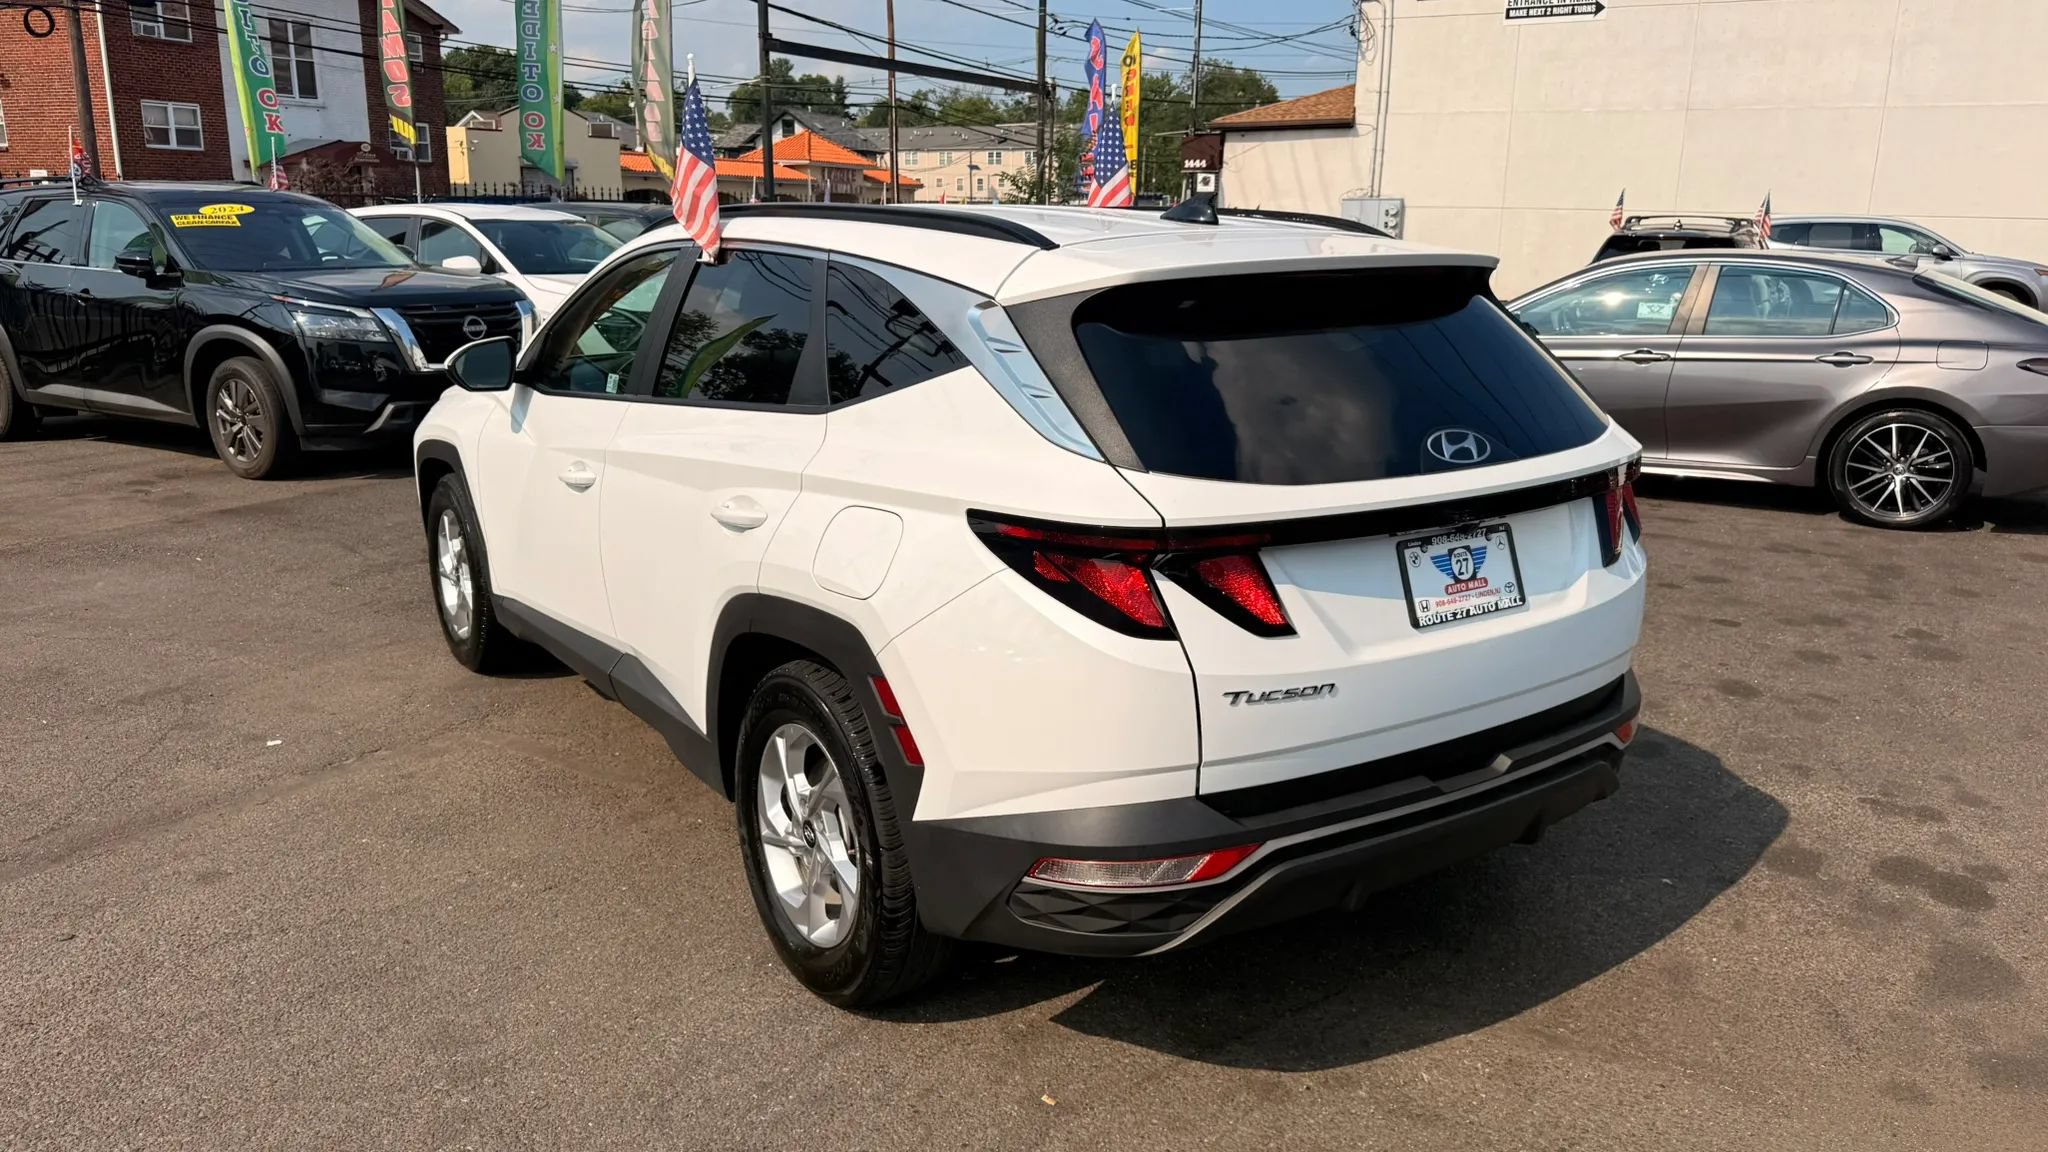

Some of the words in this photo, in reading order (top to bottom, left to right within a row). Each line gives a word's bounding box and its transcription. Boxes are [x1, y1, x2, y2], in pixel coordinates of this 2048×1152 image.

[1509, 8, 1528, 17] MAKE
[1528, 8, 1545, 16] NEXT
[1546, 7, 1551, 15] 2
[1552, 6, 1572, 14] RIGHT
[1574, 5, 1596, 13] TURNS
[233, 0, 271, 77] ITO
[257, 88, 285, 134] OK
[1184, 159, 1207, 168] 1444
[211, 206, 244, 214] 2024
[1455, 557, 1469, 576] 27
[1447, 583, 1467, 594] AUTO
[1468, 579, 1487, 590] MALL
[1419, 611, 1455, 627] ROUTE
[1456, 608, 1468, 619] 27
[1469, 603, 1496, 616] AUTO
[1497, 596, 1523, 610] MALL
